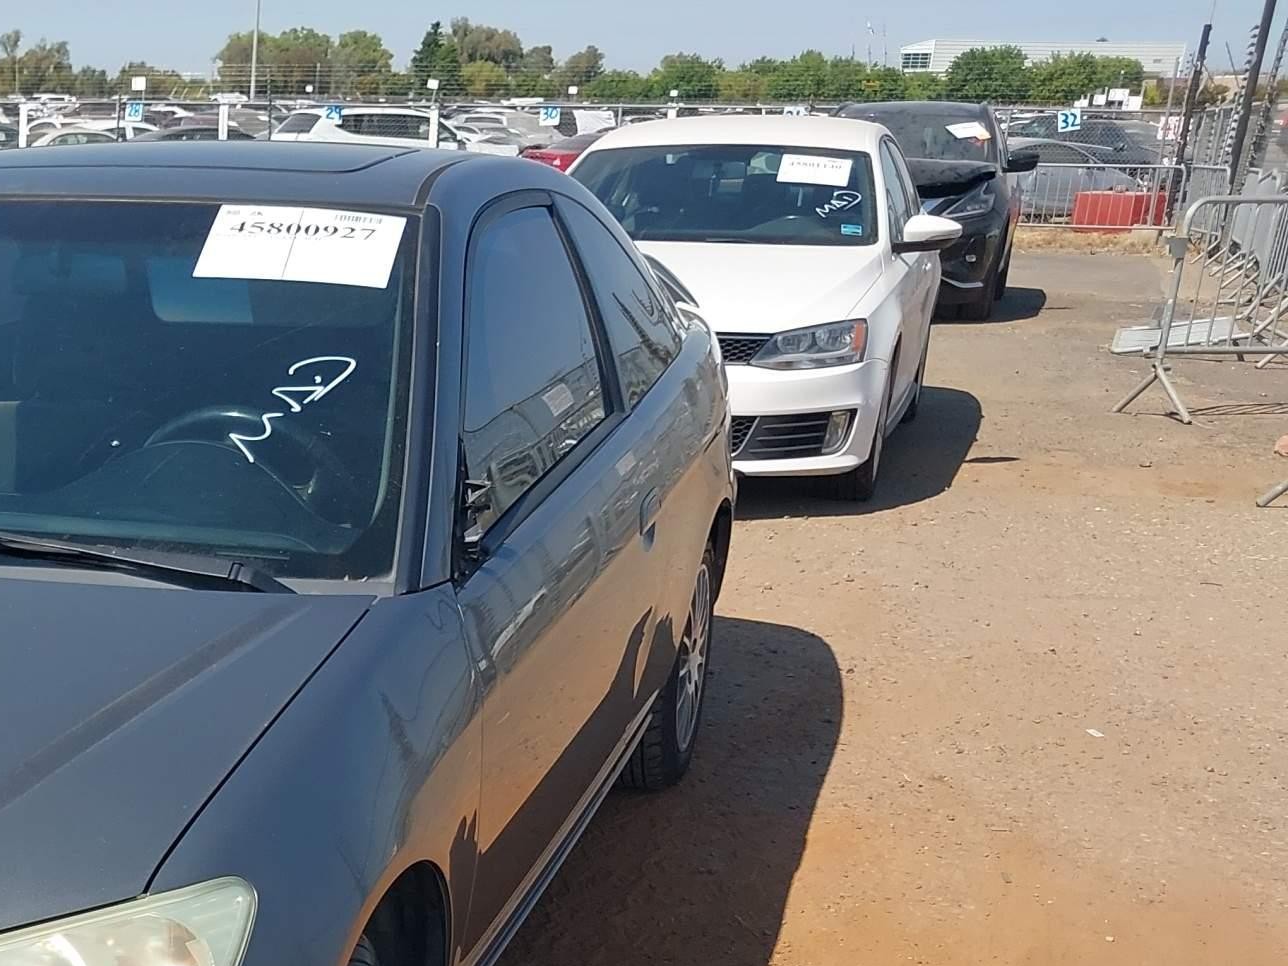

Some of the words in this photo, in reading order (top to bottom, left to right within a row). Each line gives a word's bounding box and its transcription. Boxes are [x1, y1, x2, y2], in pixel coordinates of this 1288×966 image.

[326, 105, 342, 120] 29
[543, 106, 558, 120] 30
[1060, 112, 1080, 130] 32
[229, 220, 376, 241] 45800927
